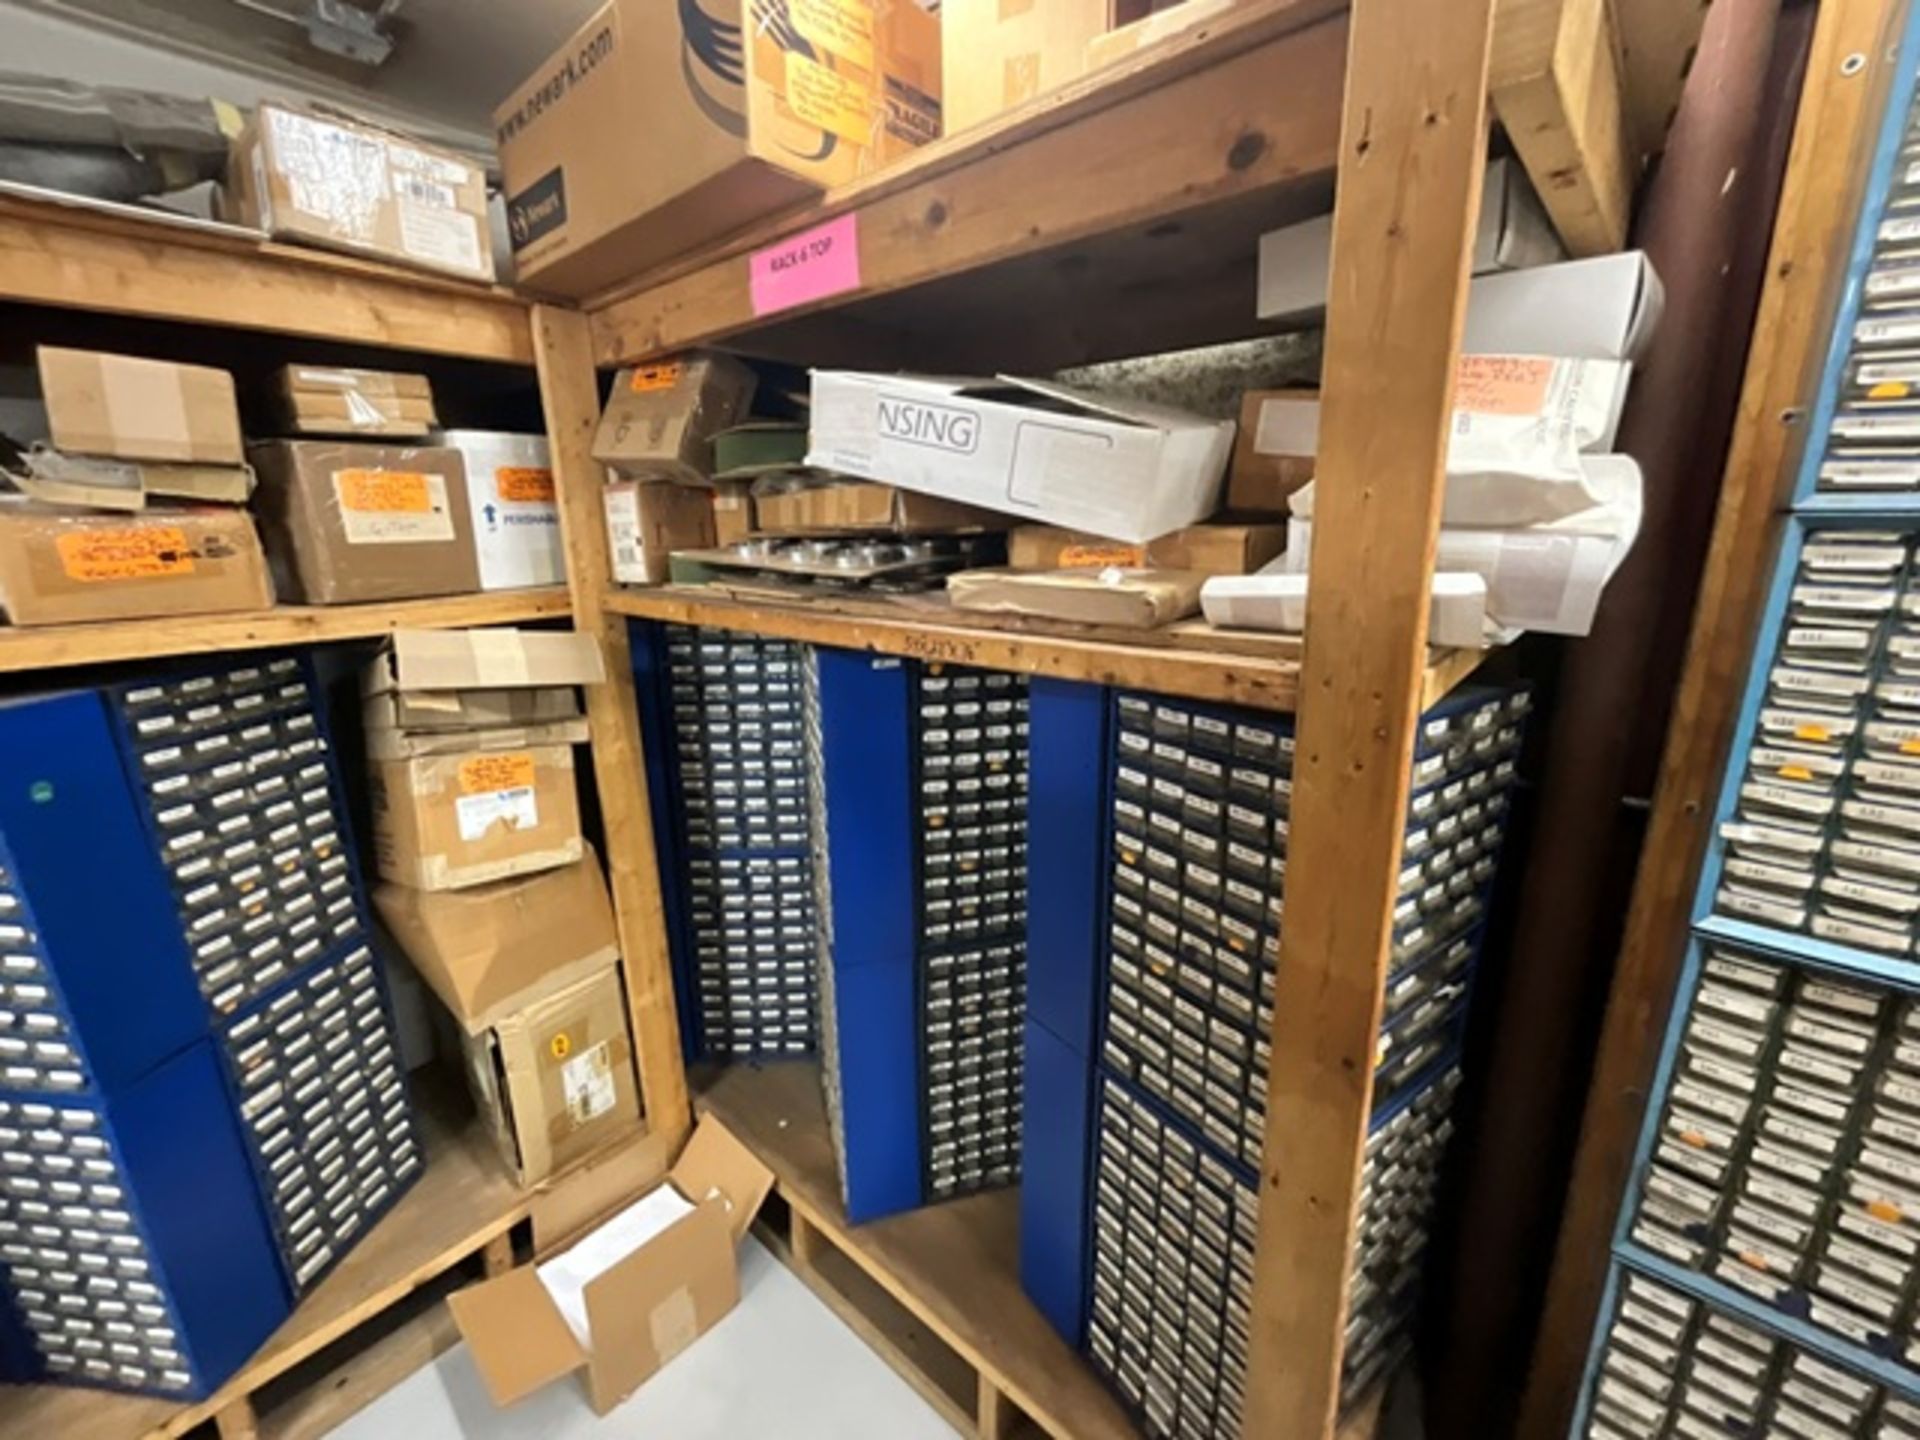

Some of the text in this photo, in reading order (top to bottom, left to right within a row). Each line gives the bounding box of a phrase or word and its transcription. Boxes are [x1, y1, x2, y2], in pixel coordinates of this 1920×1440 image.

[770, 250, 798, 272] RACK
[809, 236, 832, 259] TOP
[879, 401, 973, 447] NSING
